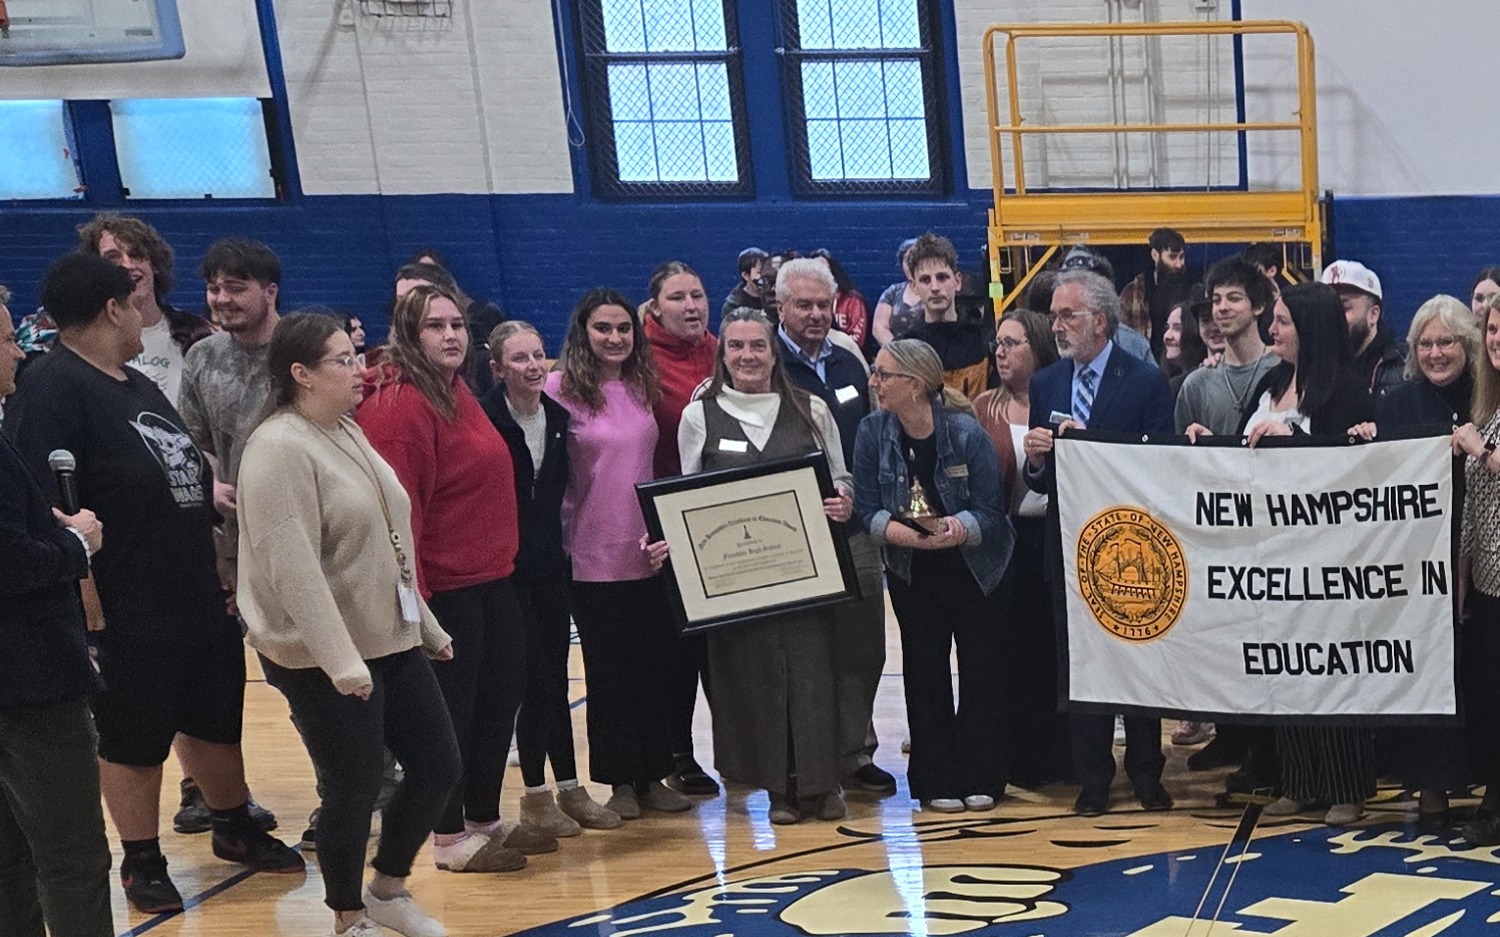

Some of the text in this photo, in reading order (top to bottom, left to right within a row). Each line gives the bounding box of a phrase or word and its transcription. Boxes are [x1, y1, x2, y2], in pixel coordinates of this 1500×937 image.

[1195, 483, 1443, 527] NEW HAMPSHIRE
[1079, 537, 1090, 559] THE
[1091, 512, 1122, 534] STATE
[1130, 513, 1144, 523] OF
[1163, 551, 1184, 622] HAMPSHIRE
[1207, 560, 1448, 601] EXCELLENCE IN
[1123, 627, 1152, 637] 1776
[1242, 639, 1415, 676] EDUCATION
